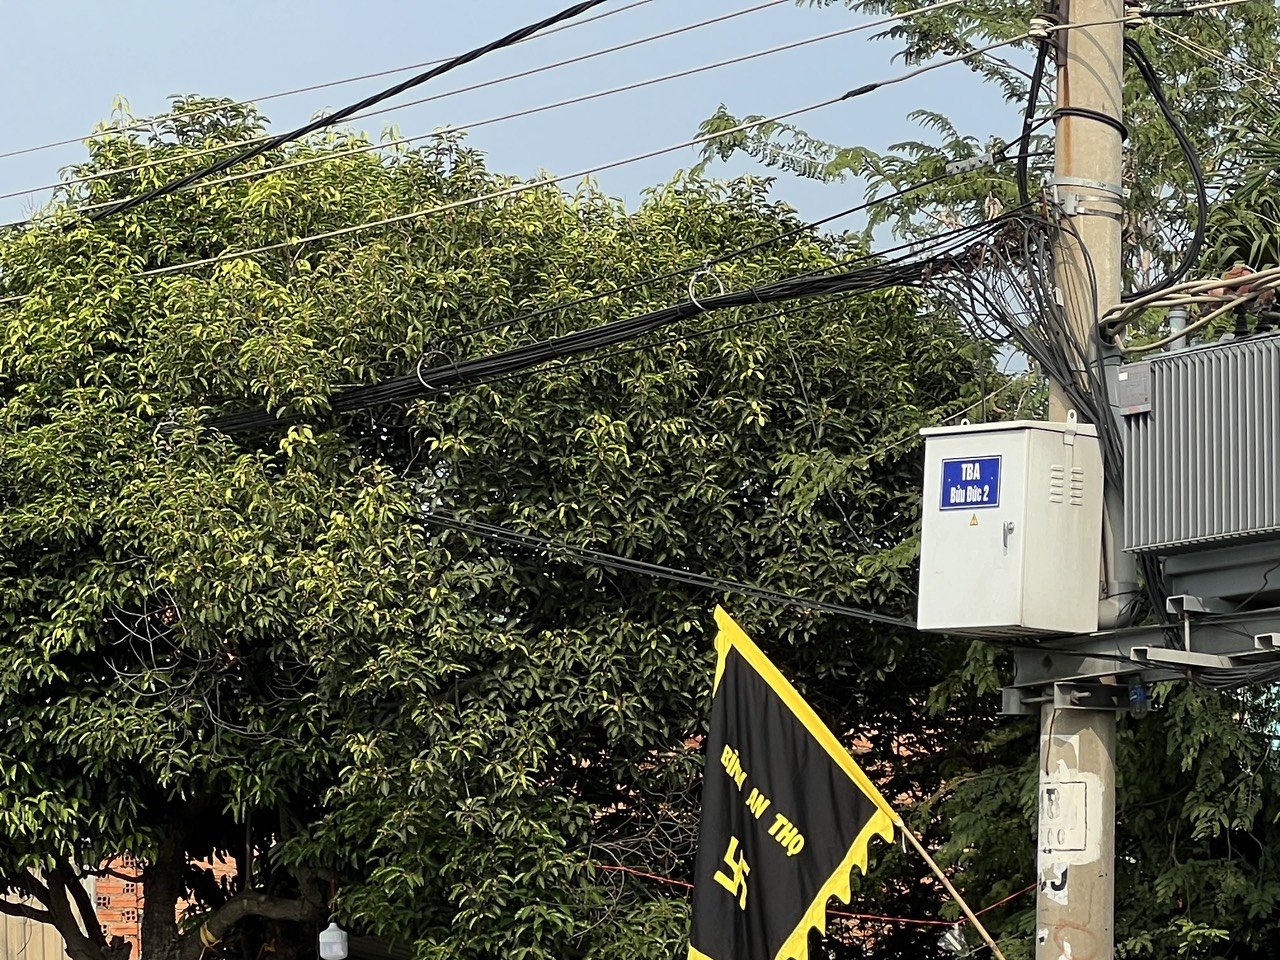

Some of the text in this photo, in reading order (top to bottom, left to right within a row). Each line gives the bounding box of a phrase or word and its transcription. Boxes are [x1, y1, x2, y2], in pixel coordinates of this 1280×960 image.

[961, 462, 980, 481] TBA
[982, 485, 989, 501] 2
[744, 787, 771, 820] AN
[767, 812, 805, 857] THỌ
